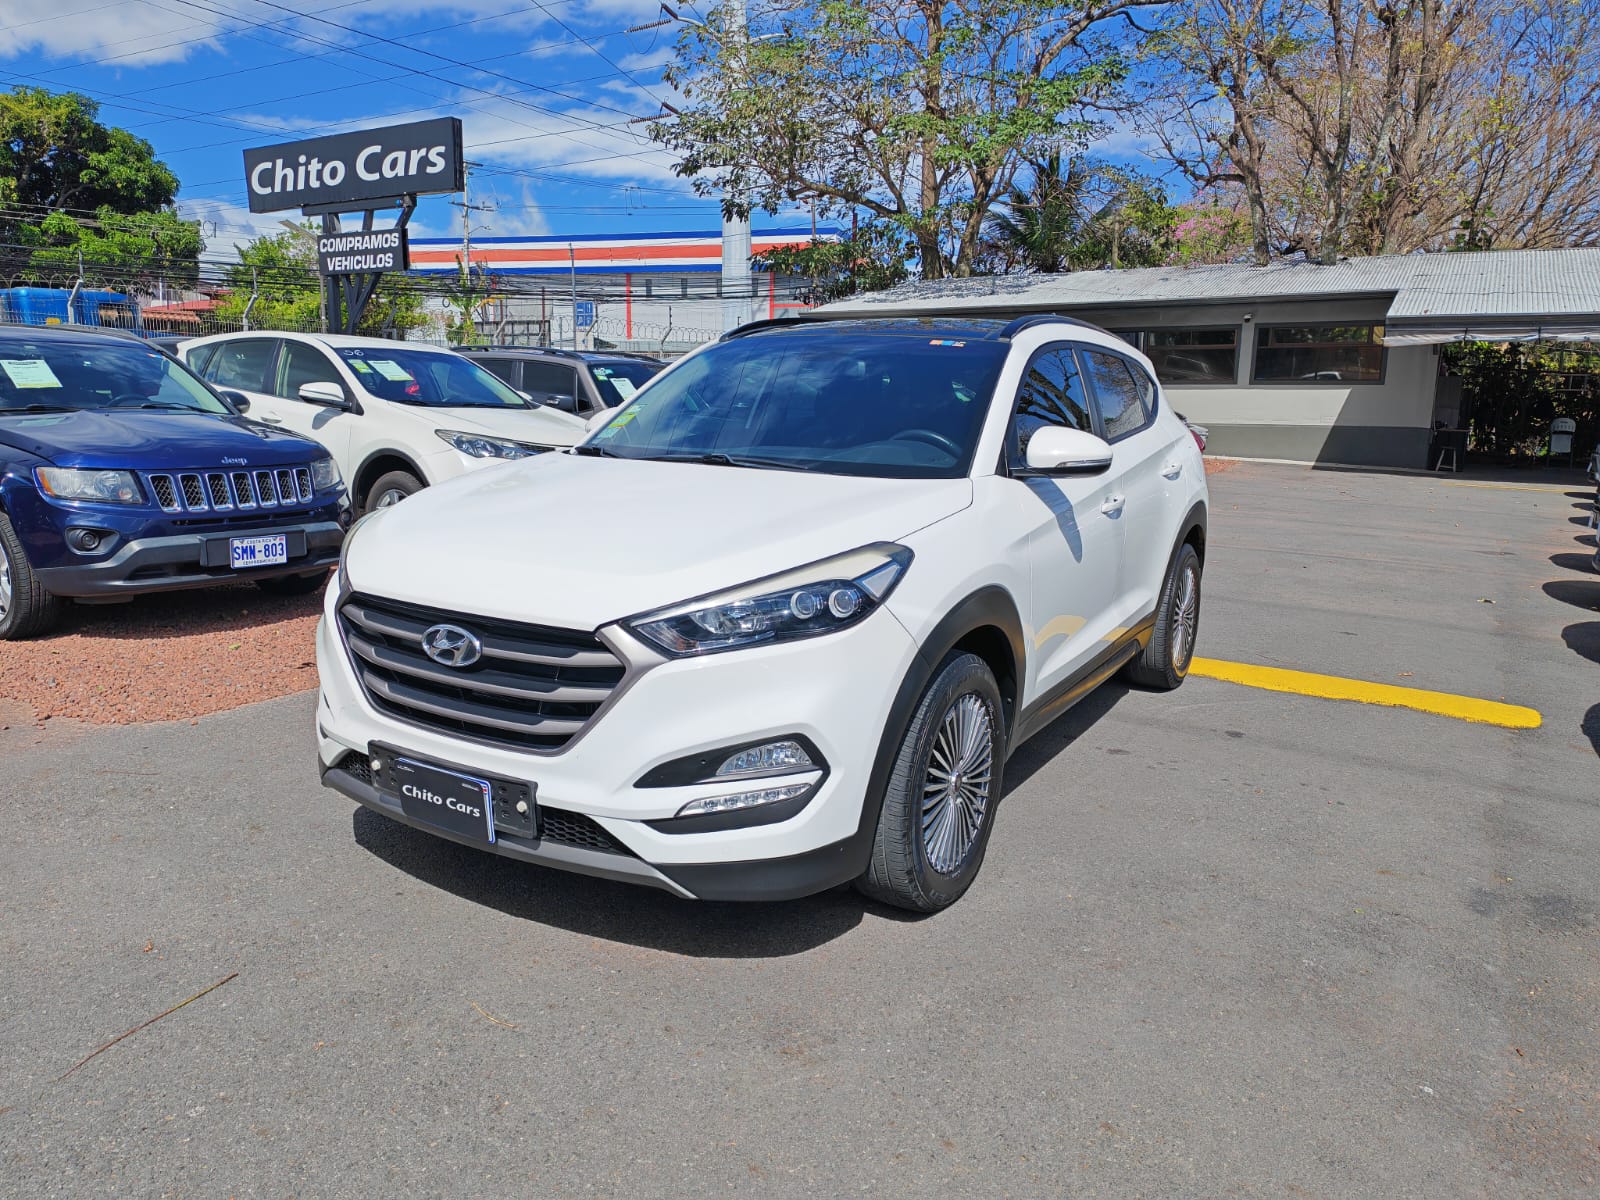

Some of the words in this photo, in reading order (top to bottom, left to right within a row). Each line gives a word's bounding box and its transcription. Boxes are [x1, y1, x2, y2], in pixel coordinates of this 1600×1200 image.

[251, 155, 345, 194] Chito
[356, 145, 445, 181] Cars
[319, 233, 399, 252] COMPRAMOS
[327, 253, 393, 271] VEHICULOS
[221, 456, 248, 466] Jeep
[233, 543, 284, 560] SMN-803
[402, 784, 442, 804] Chito
[446, 798, 480, 817] Cars
